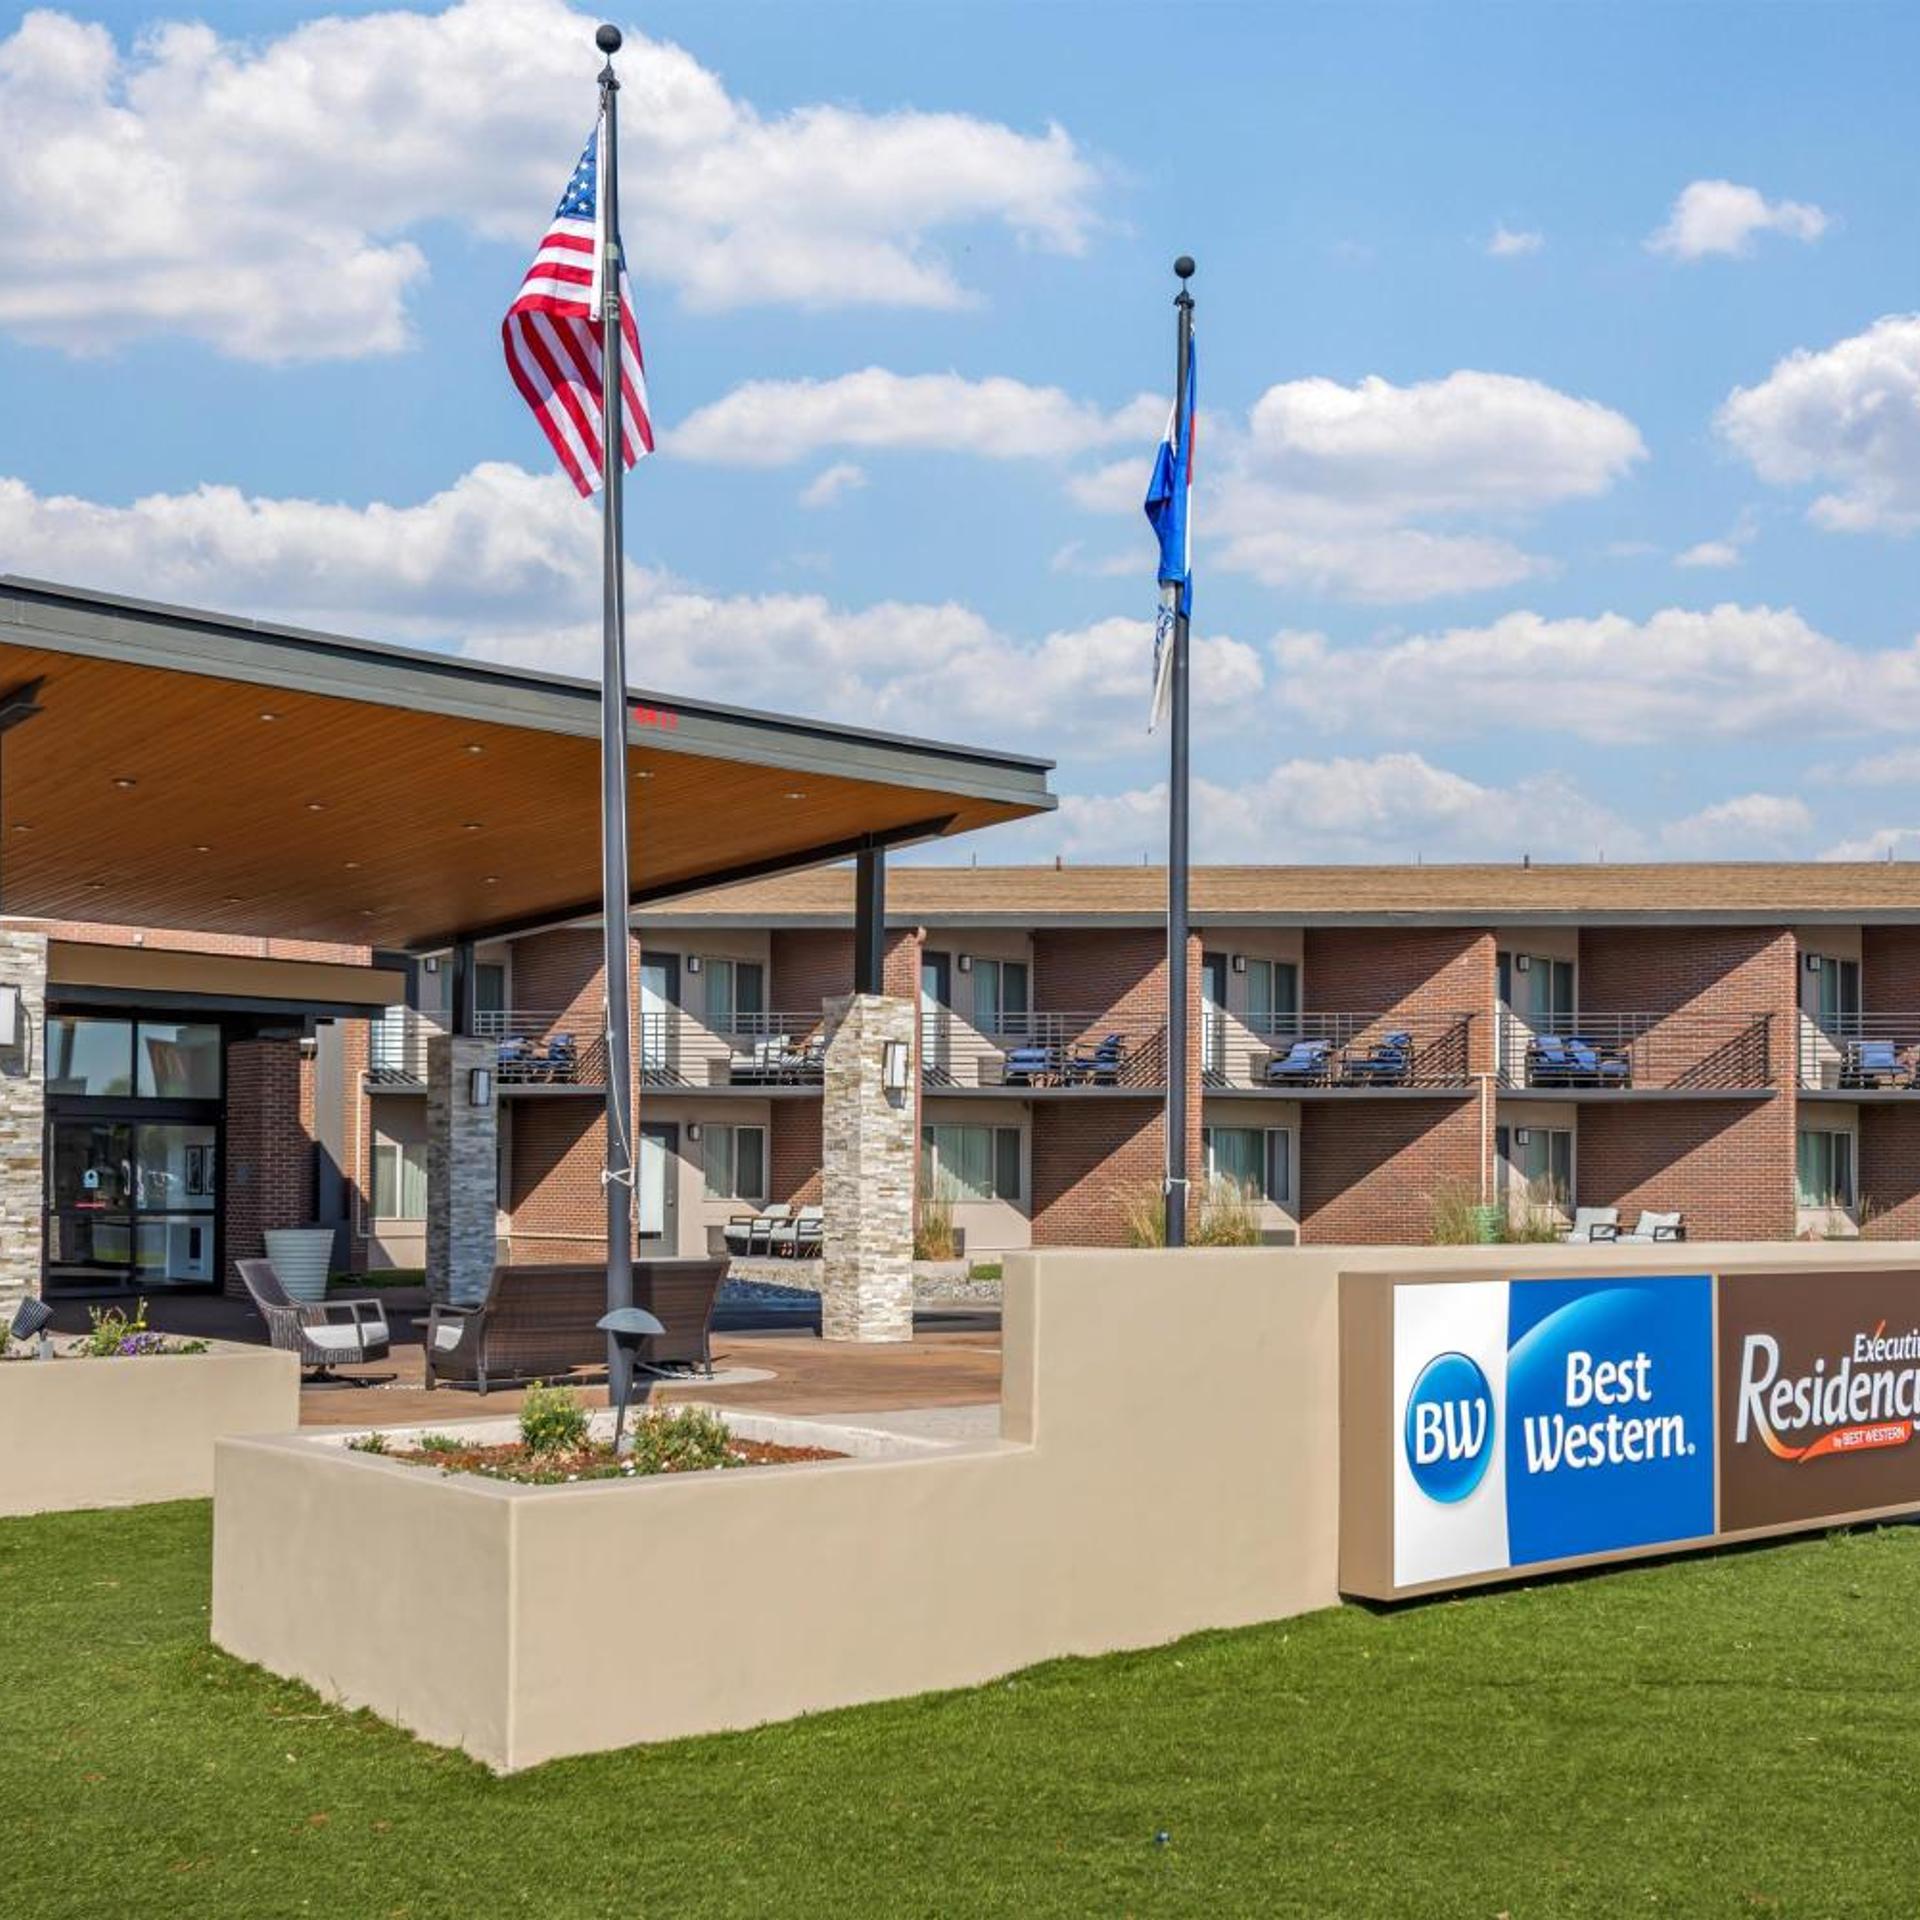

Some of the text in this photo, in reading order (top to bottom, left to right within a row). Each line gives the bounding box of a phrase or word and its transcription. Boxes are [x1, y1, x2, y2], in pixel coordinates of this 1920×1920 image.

[1854, 1328, 1920, 1362] Executi
[1566, 1351, 1652, 1407] Best
[1416, 1397, 1487, 1465] BW
[1843, 1431, 1864, 1445] BEST
[1865, 1426, 1905, 1442] WESTERN
